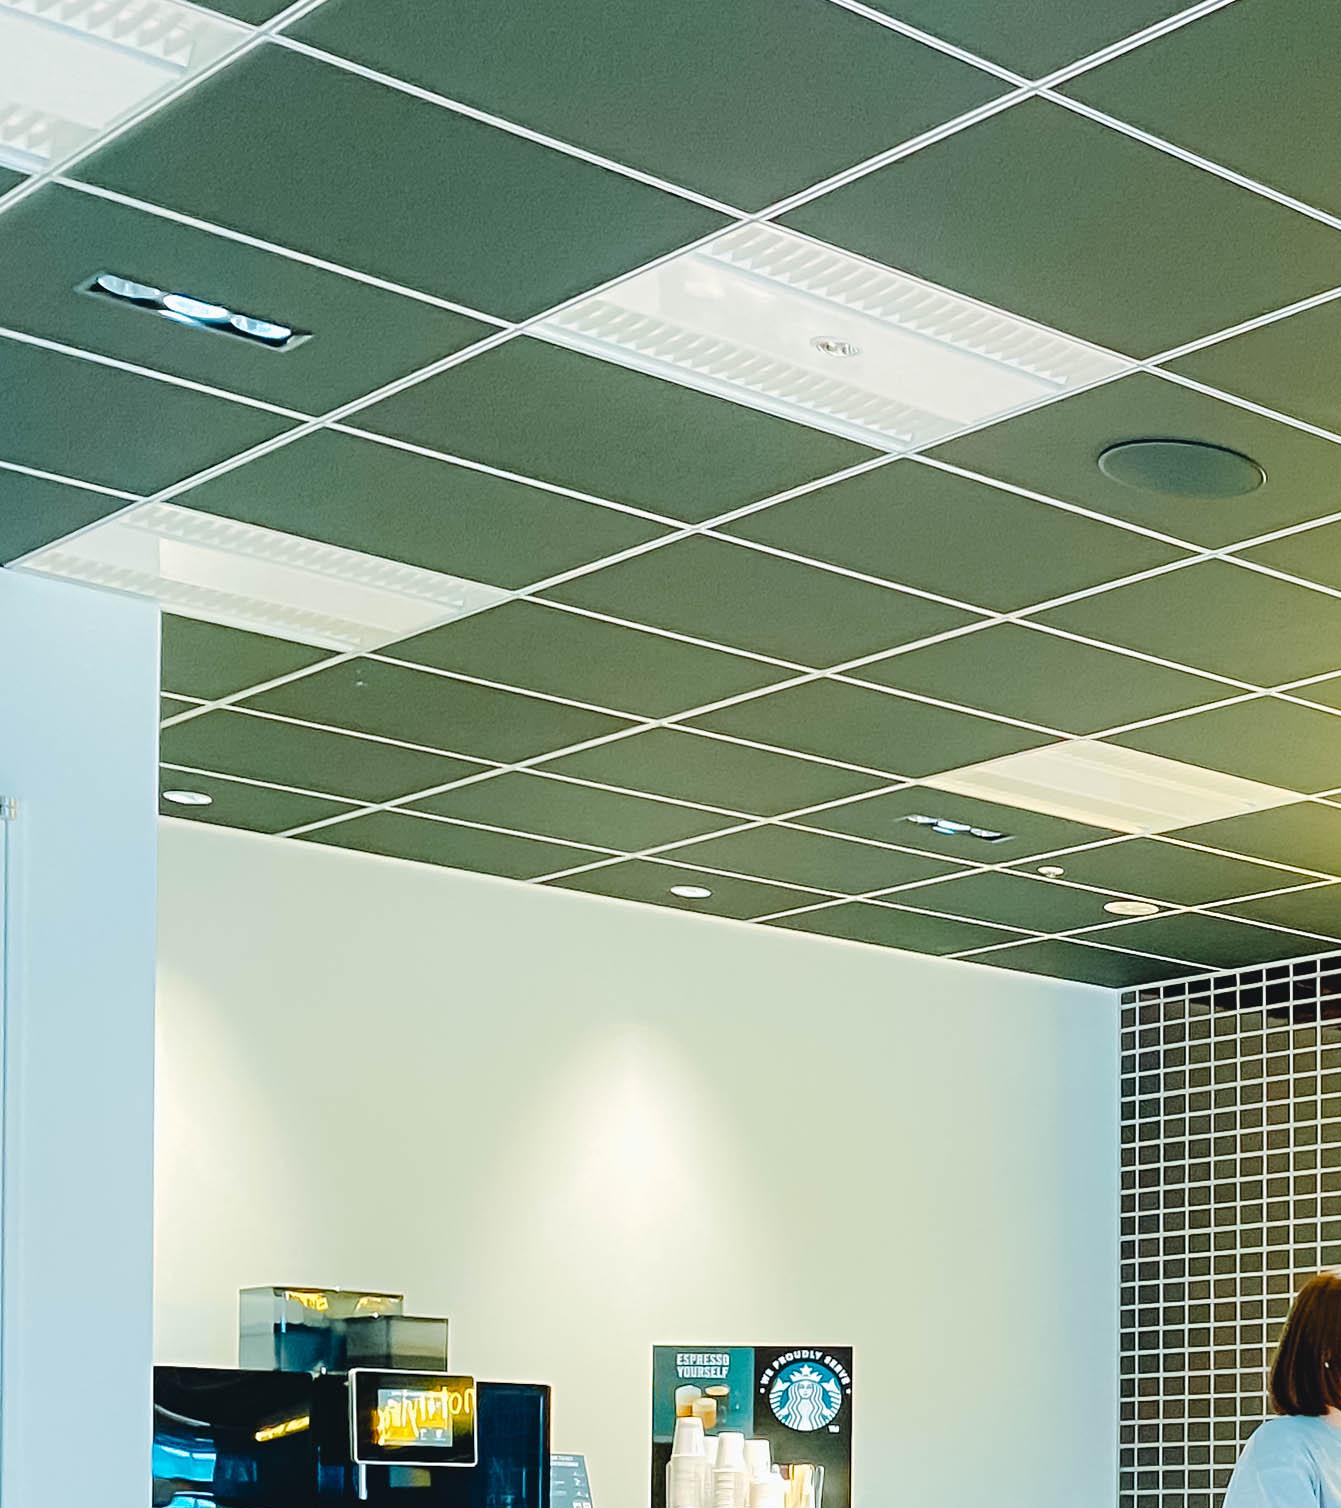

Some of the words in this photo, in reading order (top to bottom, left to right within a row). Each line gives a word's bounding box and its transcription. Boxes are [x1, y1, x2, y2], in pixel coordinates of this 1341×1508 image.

[676, 1353, 730, 1365] ESPRESSO
[772, 1349, 823, 1370] PROUDLY
[676, 1366, 729, 1378] YOURSELF
